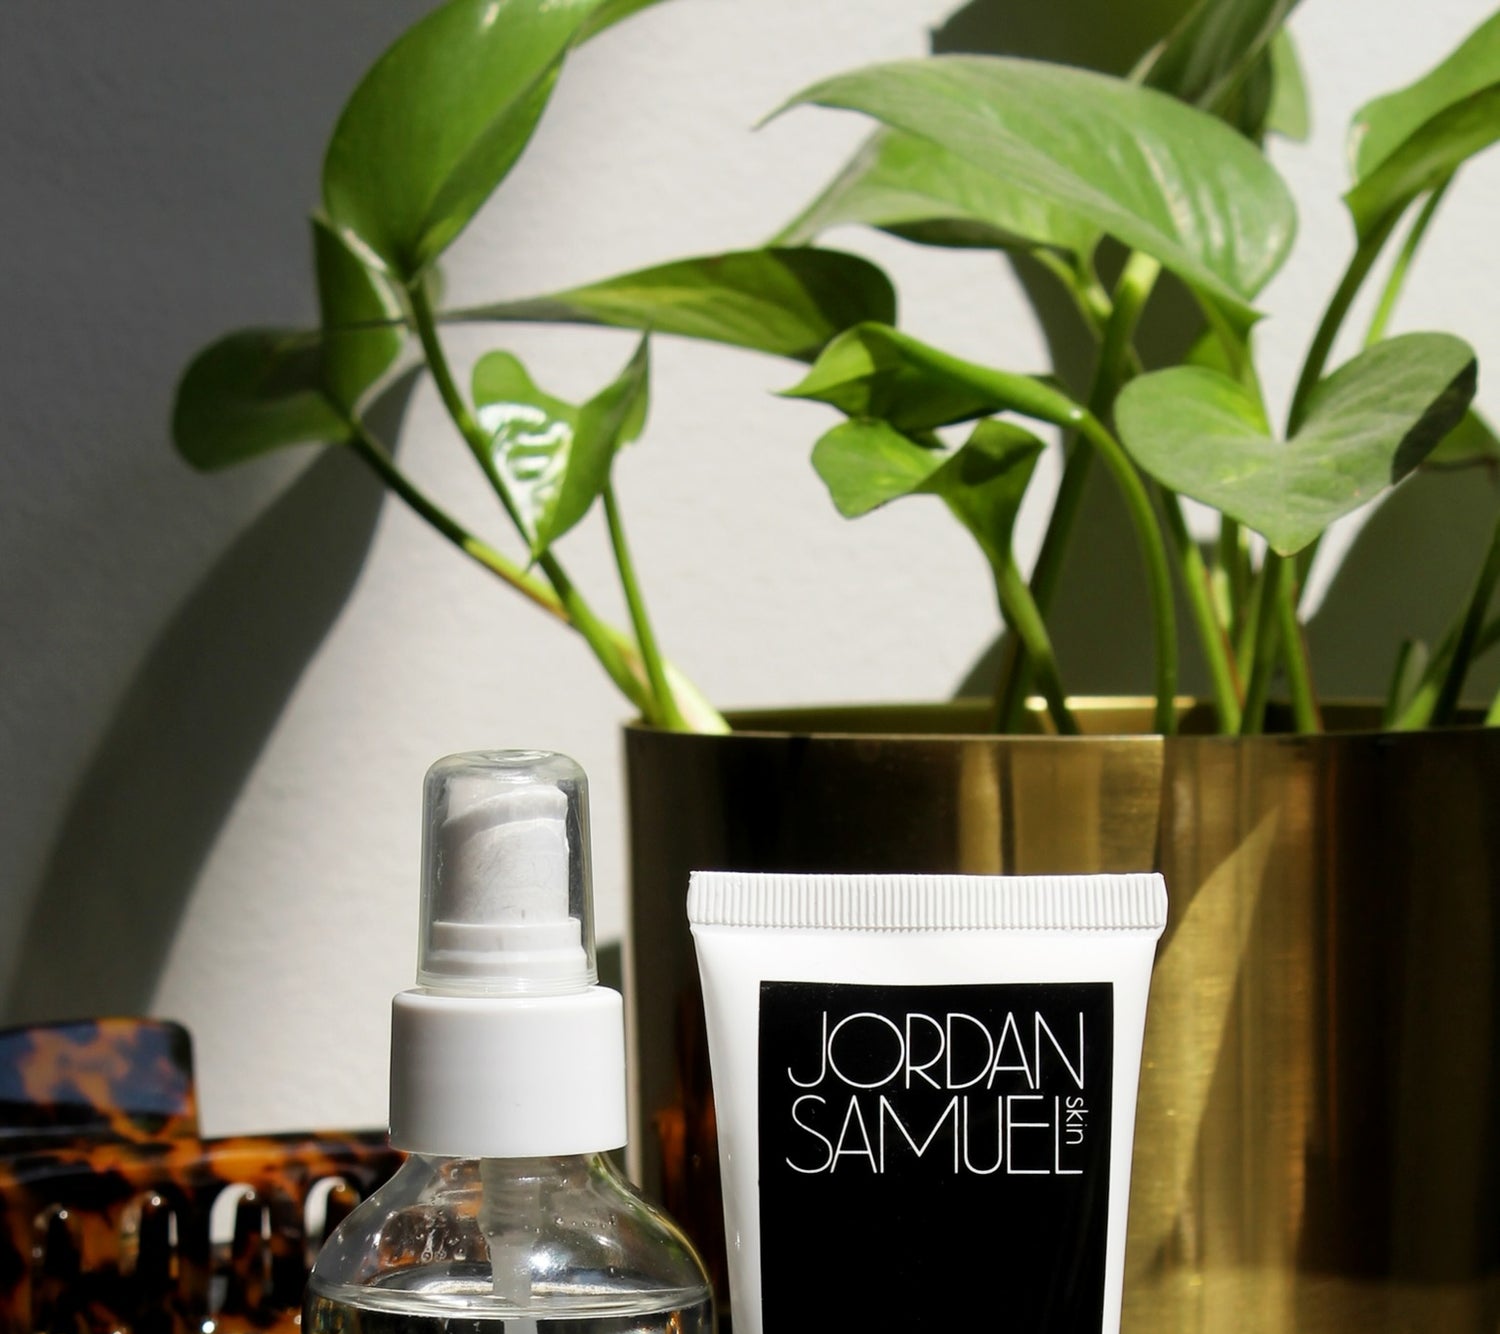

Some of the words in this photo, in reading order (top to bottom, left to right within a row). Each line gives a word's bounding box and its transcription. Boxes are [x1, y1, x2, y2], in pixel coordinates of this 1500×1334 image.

[787, 1010, 1084, 1090] JORDAN
[785, 1094, 1084, 1175] SAMUEL
[1065, 1096, 1089, 1145] skin
